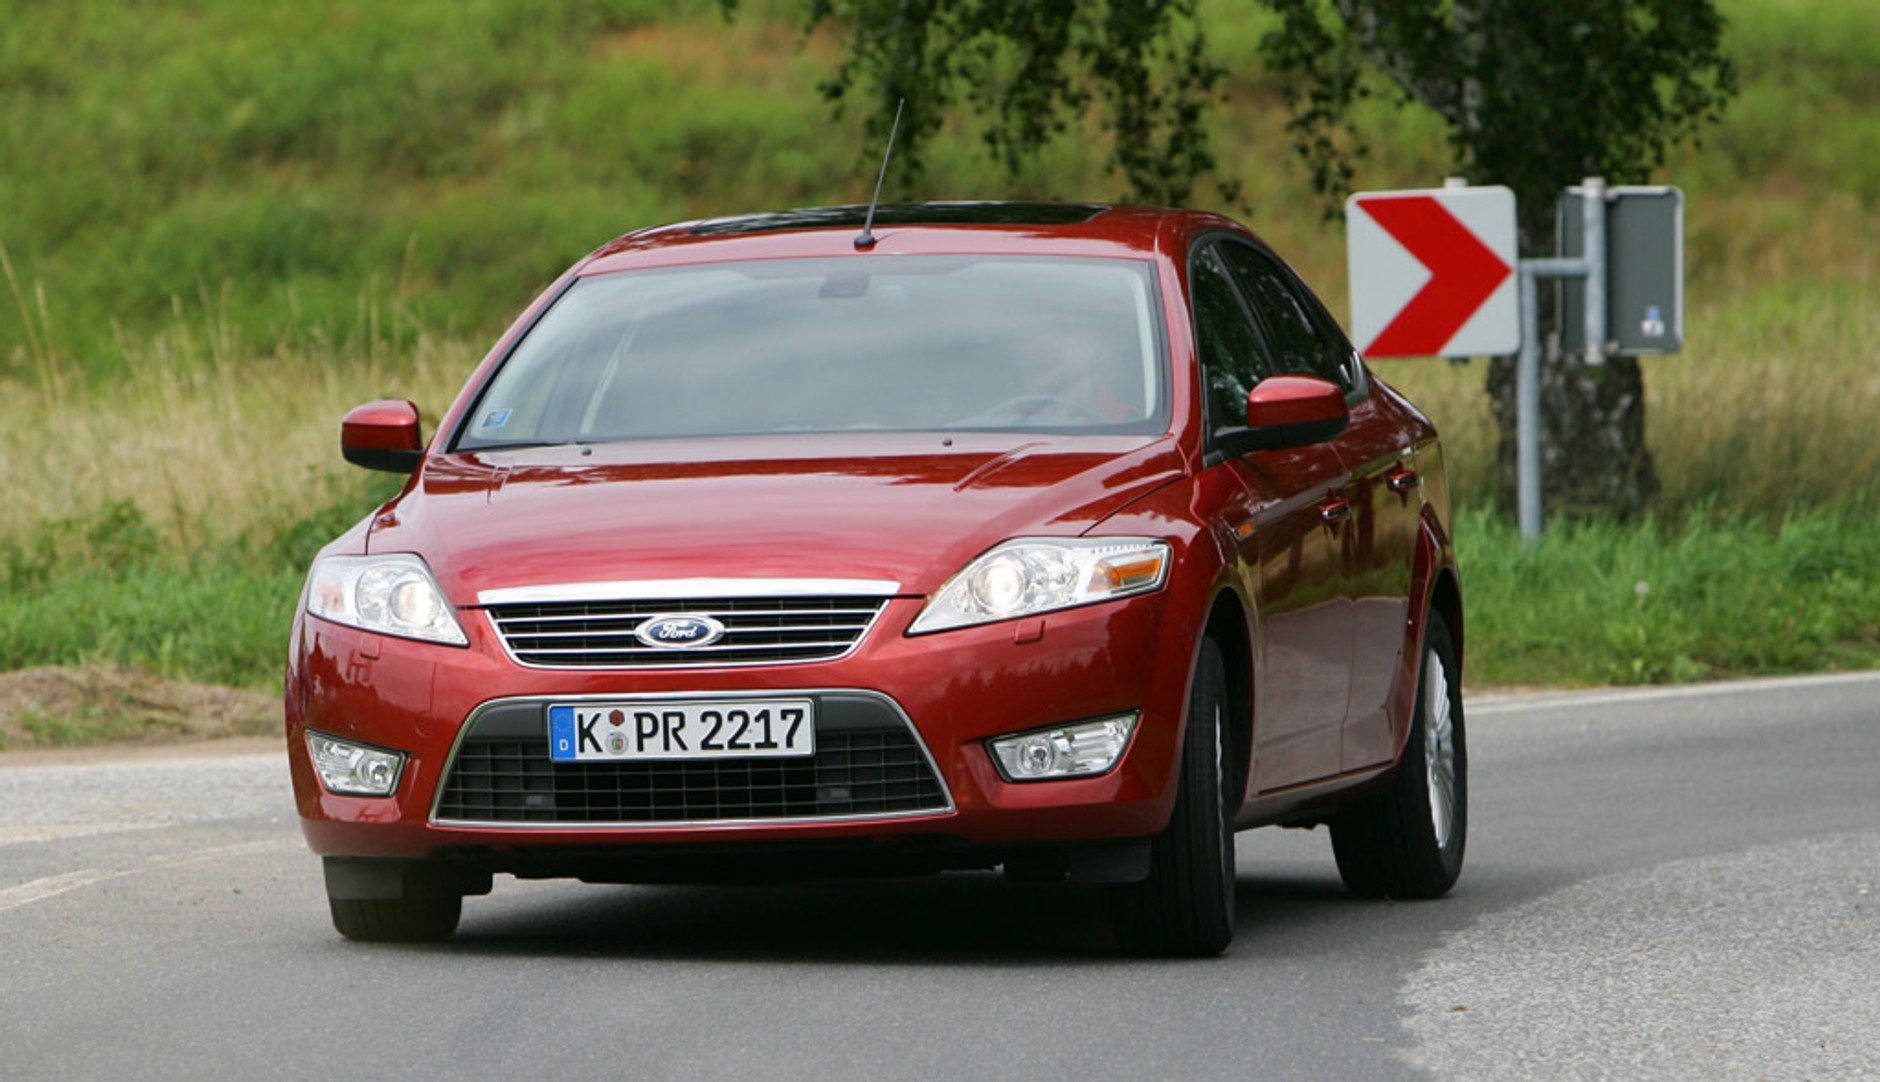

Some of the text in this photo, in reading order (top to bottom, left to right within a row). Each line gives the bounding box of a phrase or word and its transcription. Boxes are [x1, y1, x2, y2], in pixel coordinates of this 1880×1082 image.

[659, 623, 698, 639] Ford
[578, 709, 804, 752] K PR 2217
[559, 738, 569, 752] D
